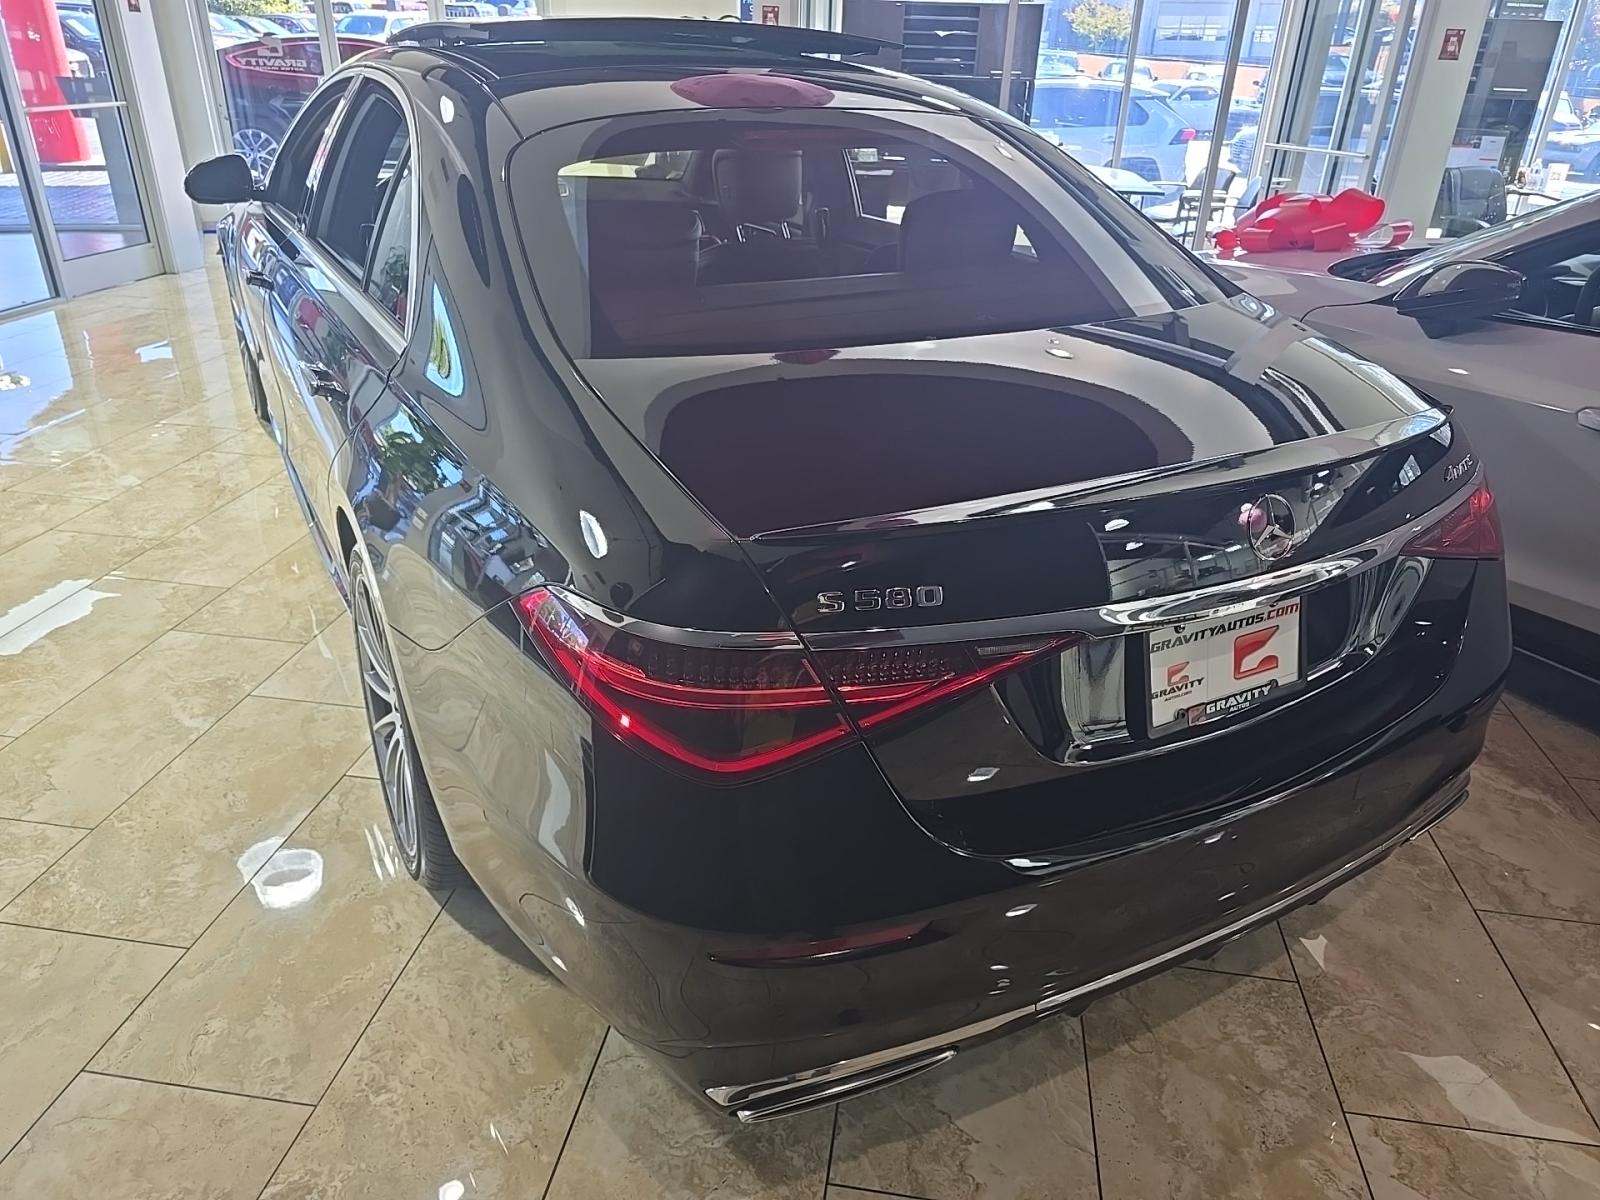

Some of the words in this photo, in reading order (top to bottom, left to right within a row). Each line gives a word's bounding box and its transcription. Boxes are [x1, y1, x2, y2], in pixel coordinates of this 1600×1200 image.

[817, 591, 845, 613] S
[854, 585, 944, 611] 580
[1151, 677, 1205, 699] GRAVITY
[1206, 685, 1271, 714] GRAVITY
[1228, 702, 1250, 712] AUTOS
